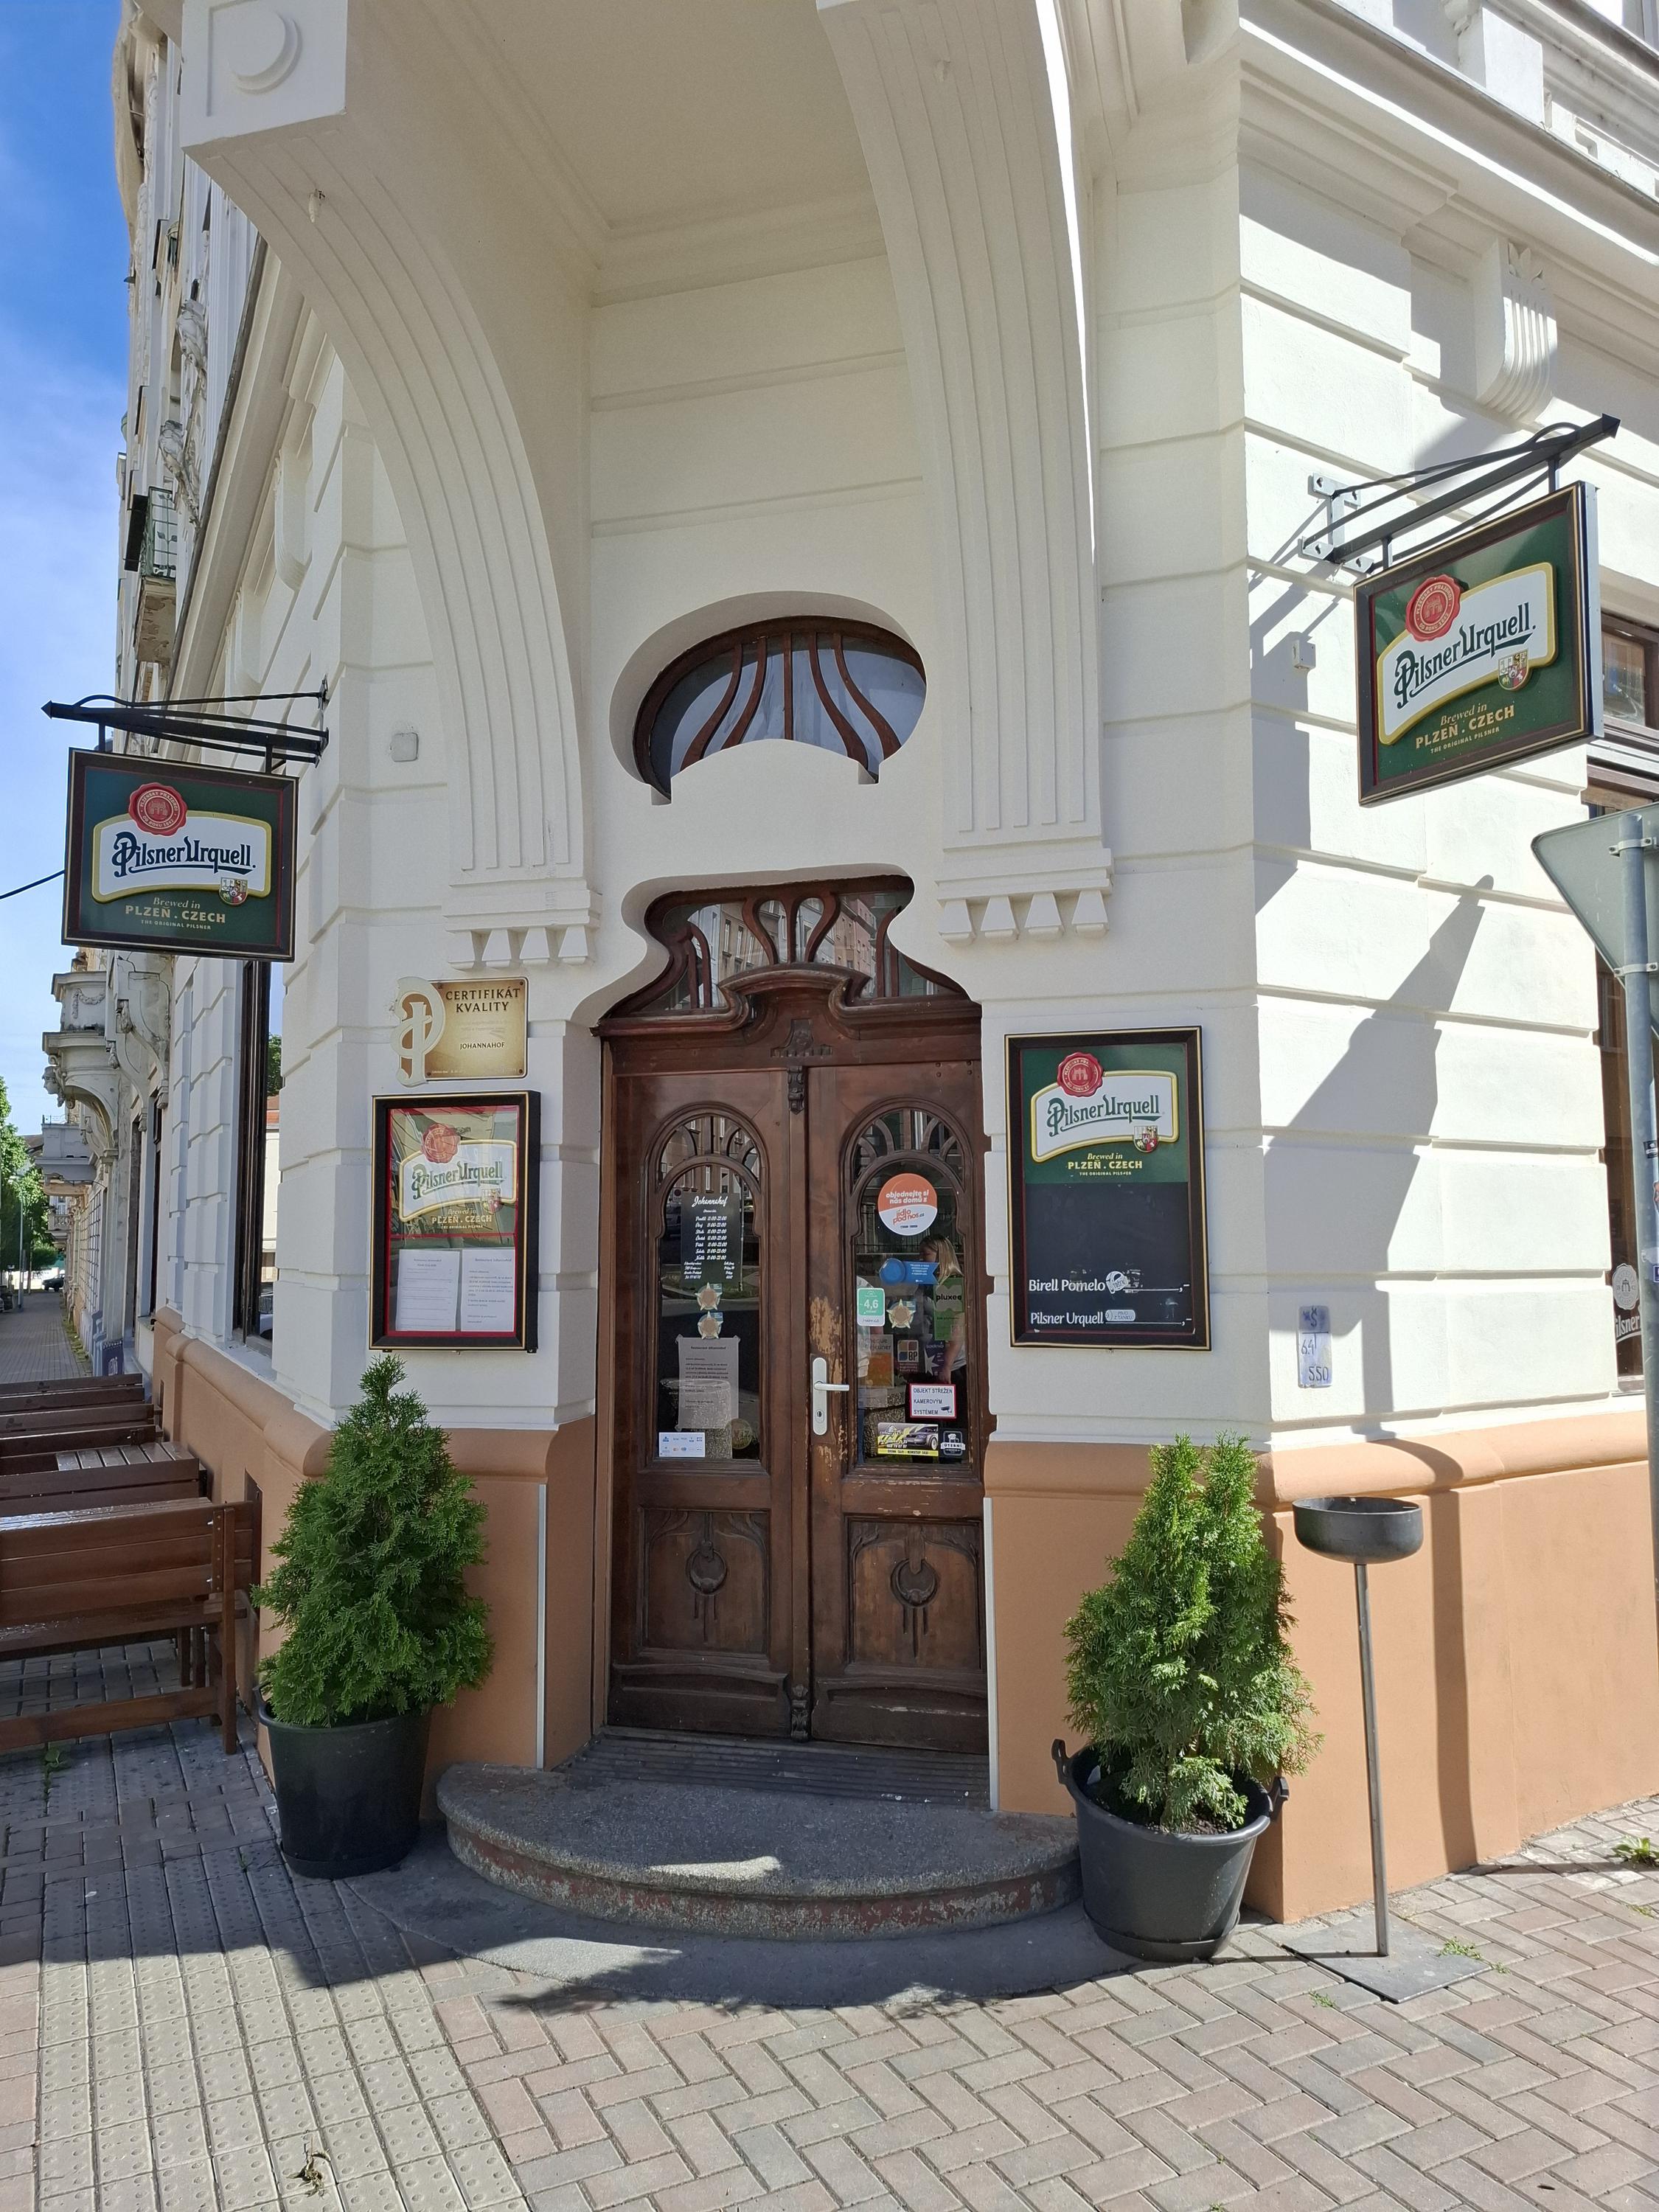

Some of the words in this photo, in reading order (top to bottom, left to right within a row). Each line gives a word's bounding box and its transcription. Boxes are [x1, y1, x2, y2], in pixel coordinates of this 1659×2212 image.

[1394, 641, 1461, 709] Pilsner
[1459, 602, 1530, 658] Urquell
[1440, 705, 1475, 726] Brewed
[1477, 703, 1487, 713] in
[1416, 722, 1458, 749] PLZEŇ
[1468, 705, 1514, 730] CZECH
[1430, 745, 1441, 754] THE
[1443, 736, 1472, 750] ORIGINAL
[1474, 726, 1500, 740] PILSNER
[111, 831, 185, 877] Pilsner
[184, 835, 251, 874] Urquell
[153, 897, 189, 908] Brewed
[191, 900, 201, 909] in
[125, 905, 170, 918] PLZEŇ
[181, 910, 226, 923] CZECH
[445, 987, 521, 1000] CERTIFIKÁT
[456, 1001, 509, 1012] KVALITY
[460, 1042, 505, 1050] JOHANNAHOF
[1046, 1097, 1104, 1137] Pilsner
[1102, 1094, 1159, 1123] Urquell
[1068, 1160, 1101, 1169] PLZEŇ
[1109, 1161, 1143, 1169] CZECH
[411, 1164, 459, 1200] Pilsner
[456, 1161, 503, 1187] Urquell
[692, 1195, 728, 1208] Johannahof
[465, 1214, 493, 1222] CZECH
[897, 1208, 911, 1219] jídlo
[1029, 1279, 1059, 1291] Birell
[1062, 1278, 1105, 1291] Pomelo
[863, 1299, 879, 1310] 4,6
[1031, 1312, 1065, 1324] Pilsner
[1066, 1311, 1104, 1327] Urquell
[908, 1352, 918, 1361] BP
